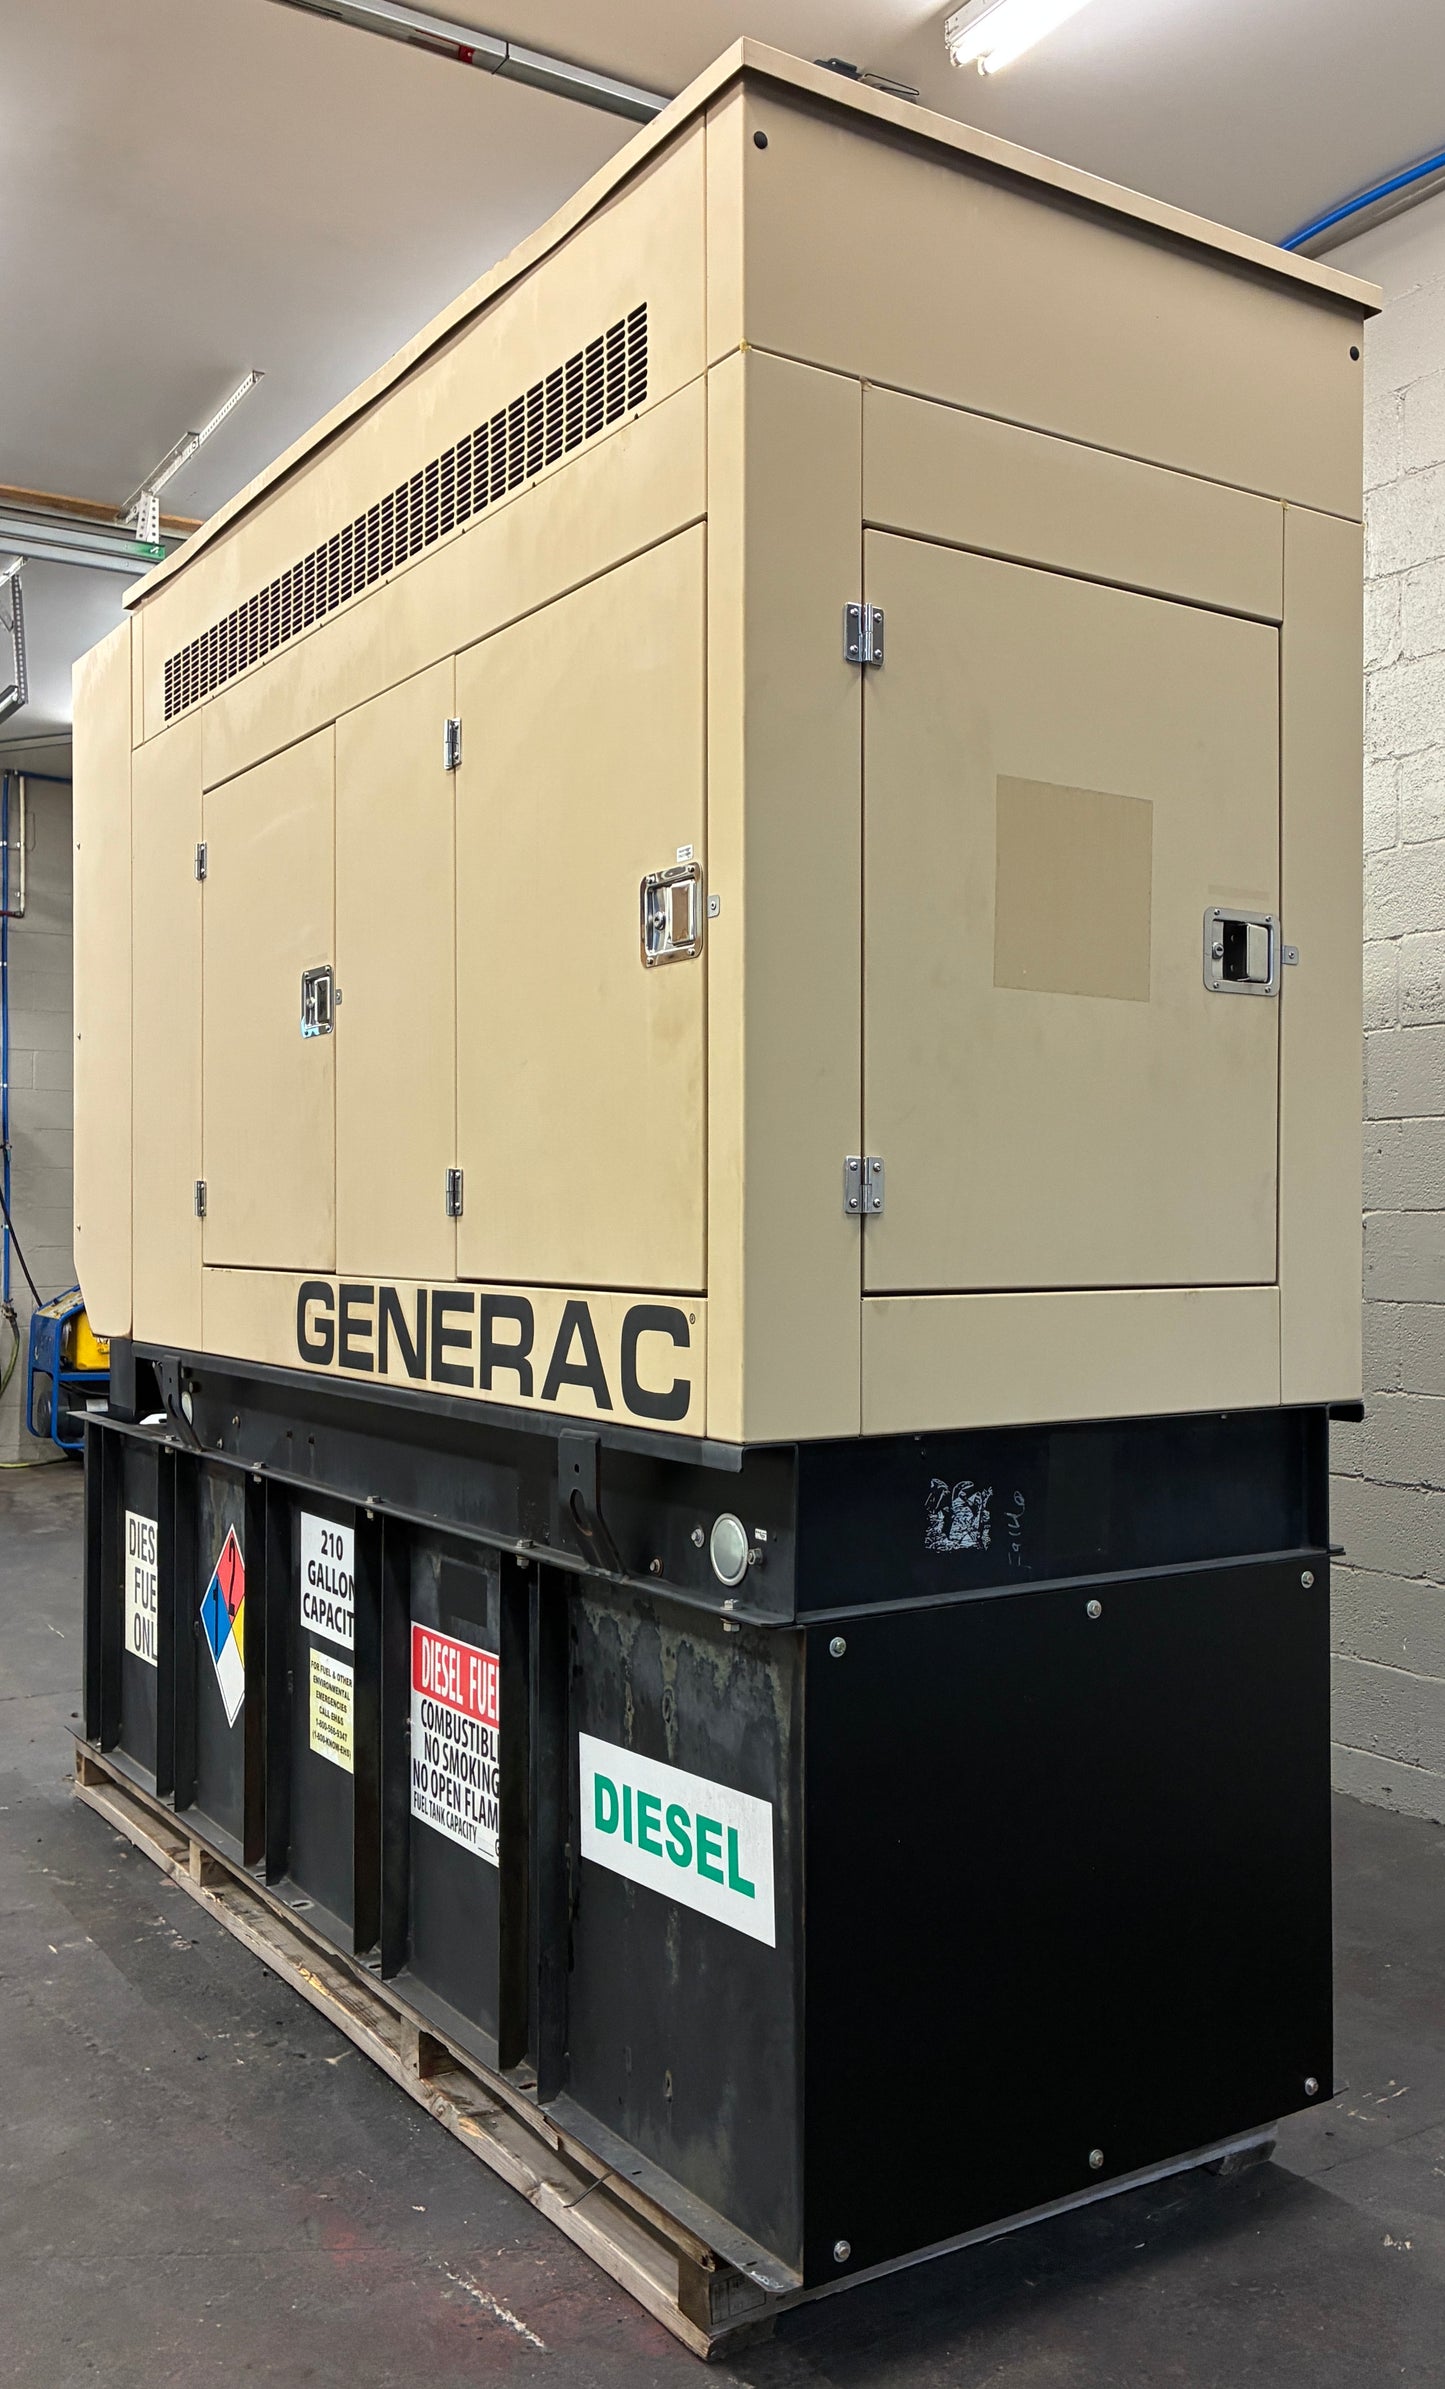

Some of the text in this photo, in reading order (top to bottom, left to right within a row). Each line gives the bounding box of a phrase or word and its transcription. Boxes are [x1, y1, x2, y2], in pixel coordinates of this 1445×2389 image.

[297, 1281, 691, 1421] GENERAC
[320, 1529, 344, 1561] 210
[307, 1560, 355, 1601] GALLON
[303, 1592, 355, 1638] CAPACIT
[311, 1660, 320, 1671] FOR
[320, 1664, 331, 1677] FUEL
[337, 1673, 352, 1688] OTHER
[313, 1674, 350, 1701] ENVIRONMENTAL
[422, 1635, 464, 1706] DIESEL
[315, 1690, 347, 1713] EMERGENCIES
[319, 1705, 330, 1719] CALL
[421, 1699, 500, 1764] COMBUSTIBL
[424, 1732, 500, 1799] NO SMOKING
[413, 1758, 500, 1833] NO OPEN FLAM
[414, 1791, 429, 1815] FUEL
[429, 1800, 445, 1826] TANK
[446, 1811, 477, 1844] CAPACITY
[594, 1772, 756, 1899] DIESEL
